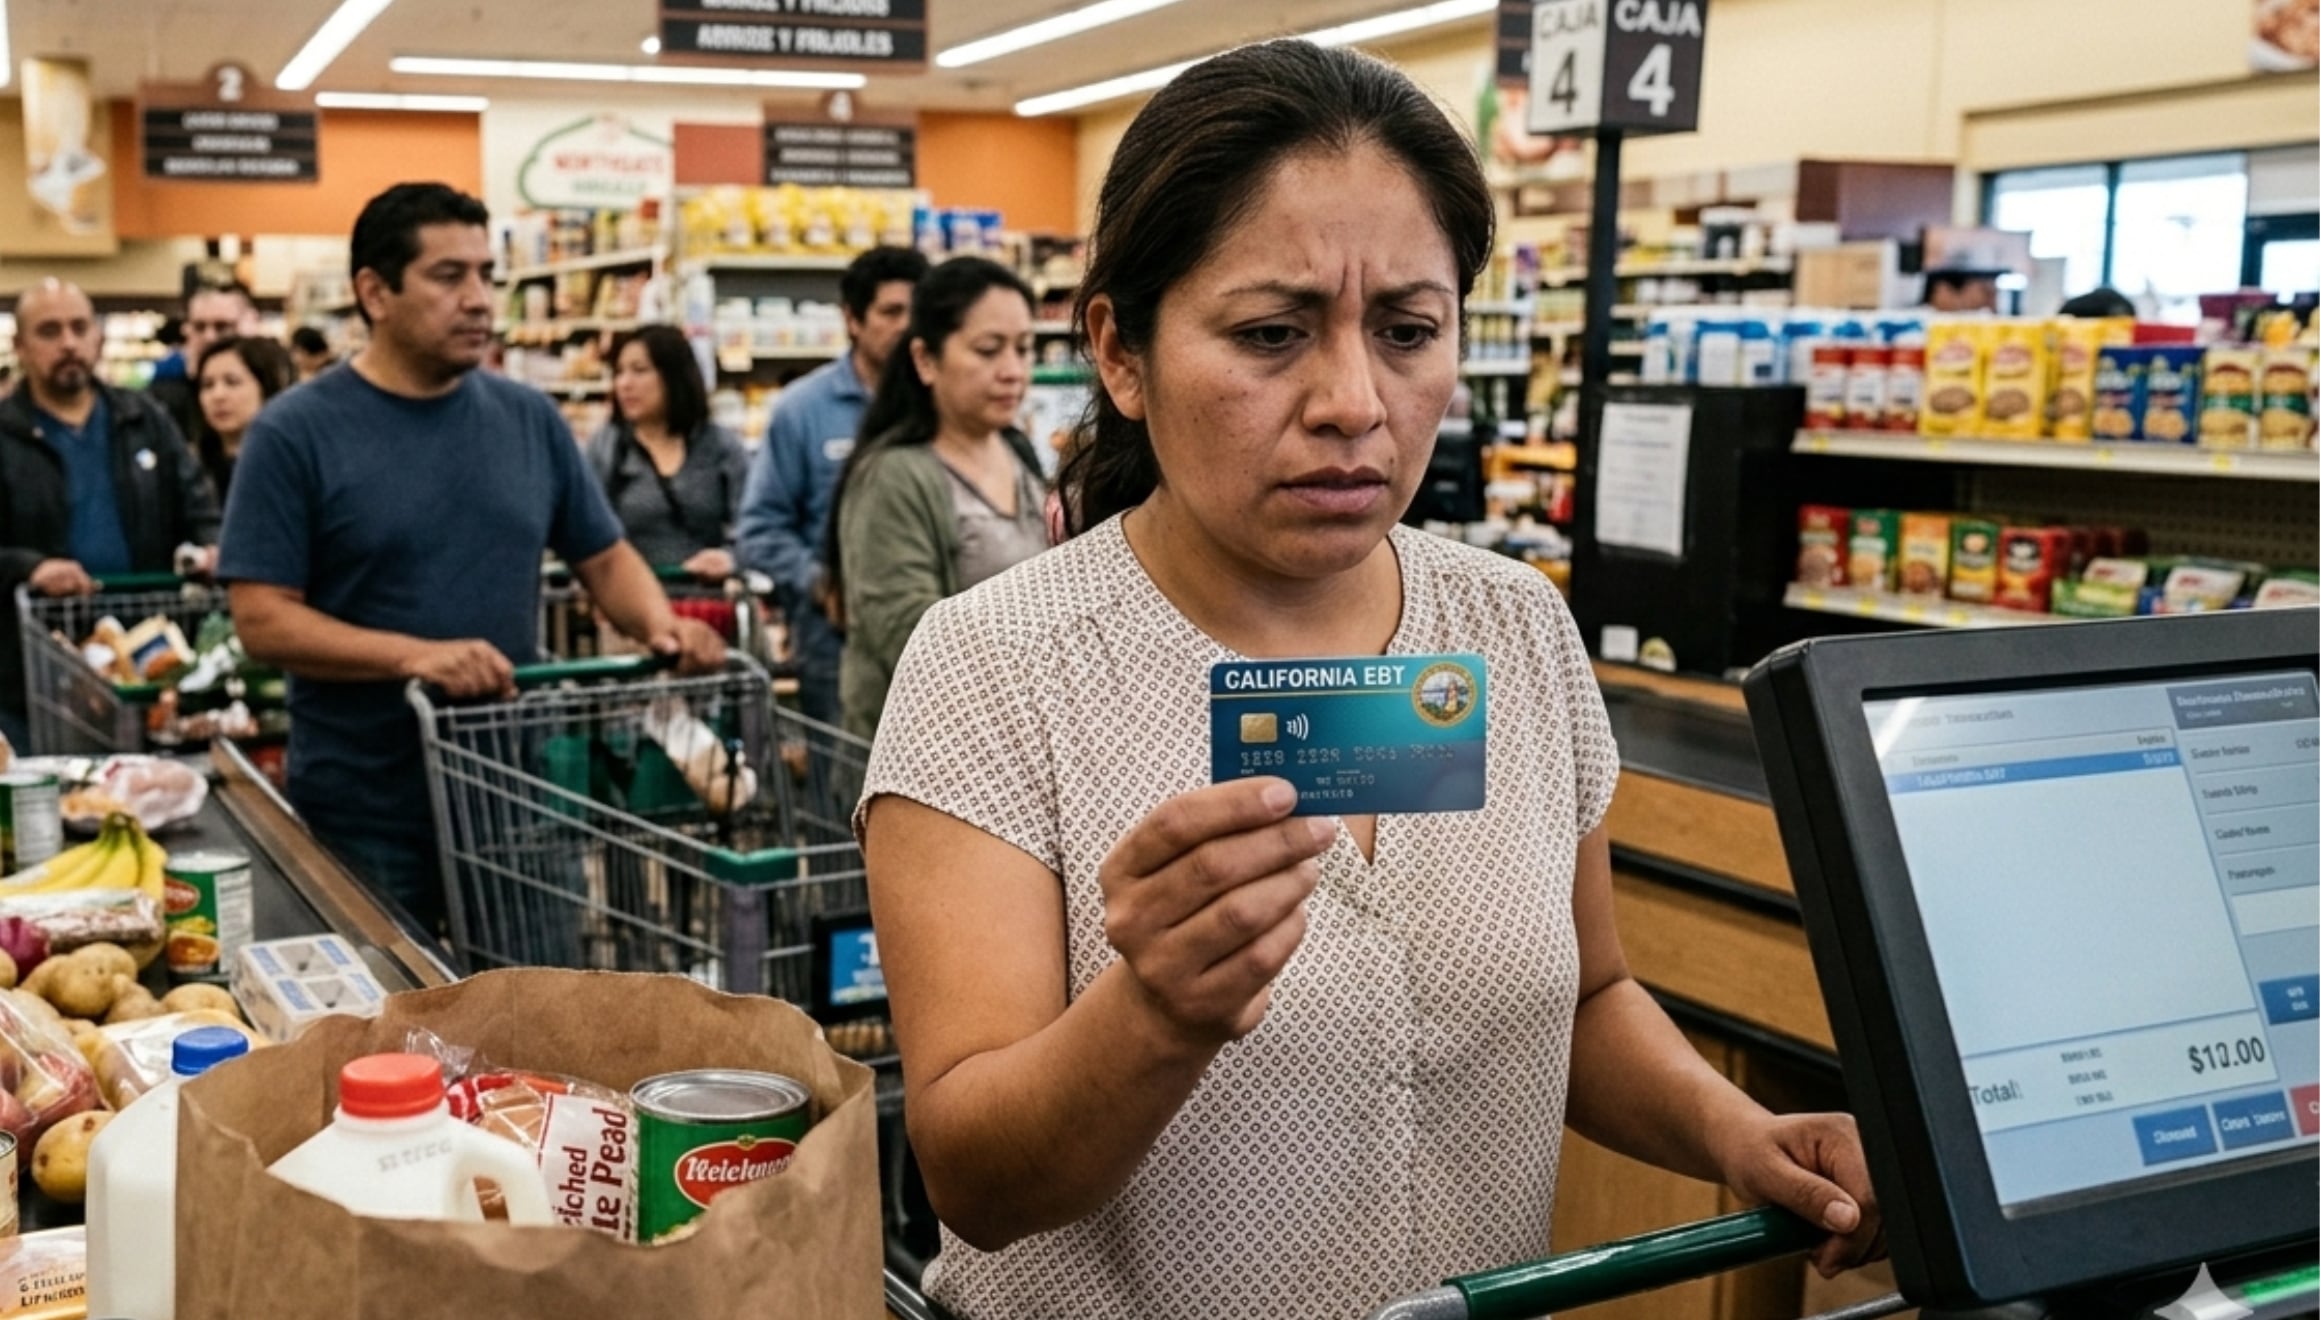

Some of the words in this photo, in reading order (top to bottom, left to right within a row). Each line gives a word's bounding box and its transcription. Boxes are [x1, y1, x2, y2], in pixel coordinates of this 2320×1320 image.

[1540, 2, 1598, 40] CAJA
[1614, 0, 1701, 38] CAJA
[217, 66, 243, 102] 2
[1550, 49, 1578, 114] 4
[1627, 42, 1676, 117] 4
[1224, 667, 1357, 690] CALIFORNIA
[1364, 664, 1406, 686] EBT
